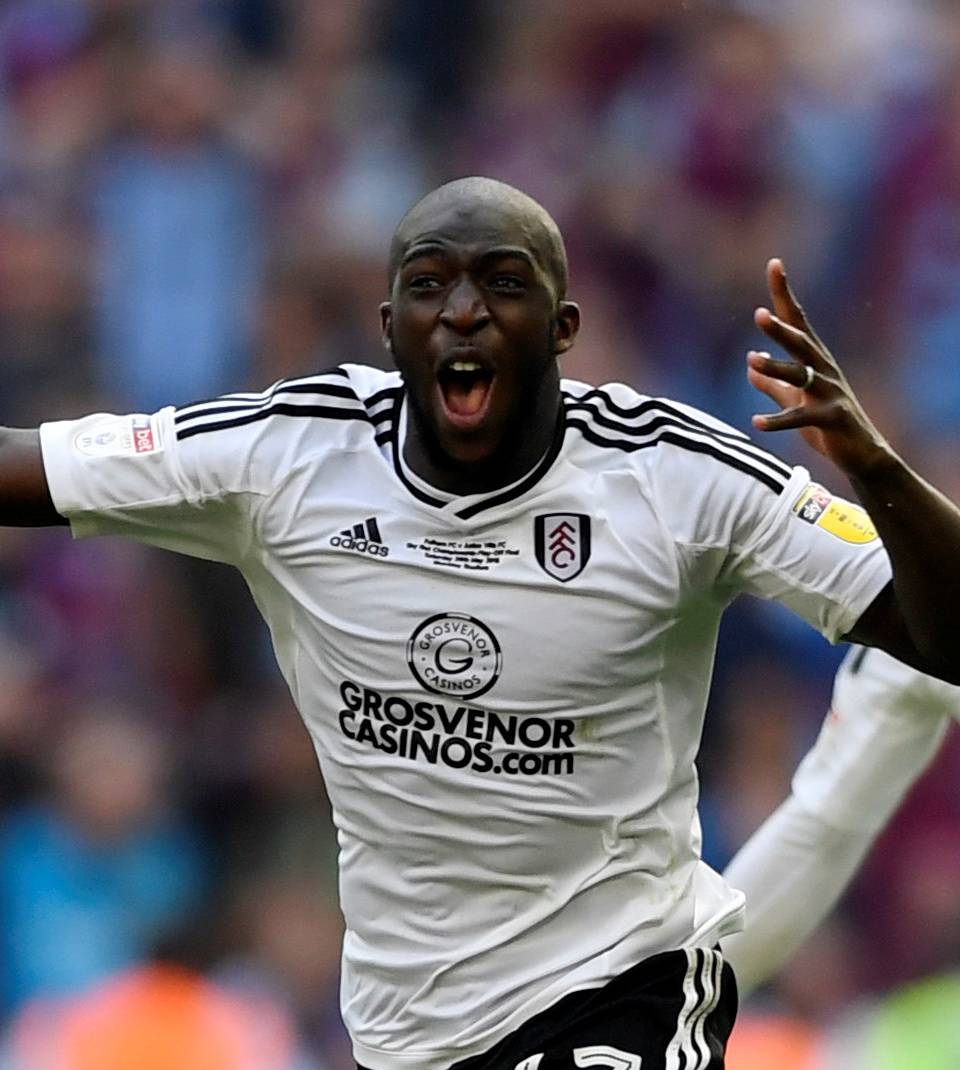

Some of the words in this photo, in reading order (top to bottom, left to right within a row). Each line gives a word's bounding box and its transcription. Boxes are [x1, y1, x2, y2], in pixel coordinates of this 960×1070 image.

[329, 535, 390, 558] adidas
[419, 622, 491, 658] GROSVENOR
[434, 637, 474, 675] G
[424, 667, 481, 690] CASINOS
[339, 680, 576, 749] GROSVENOR
[338, 710, 575, 775] CASINOS.com
